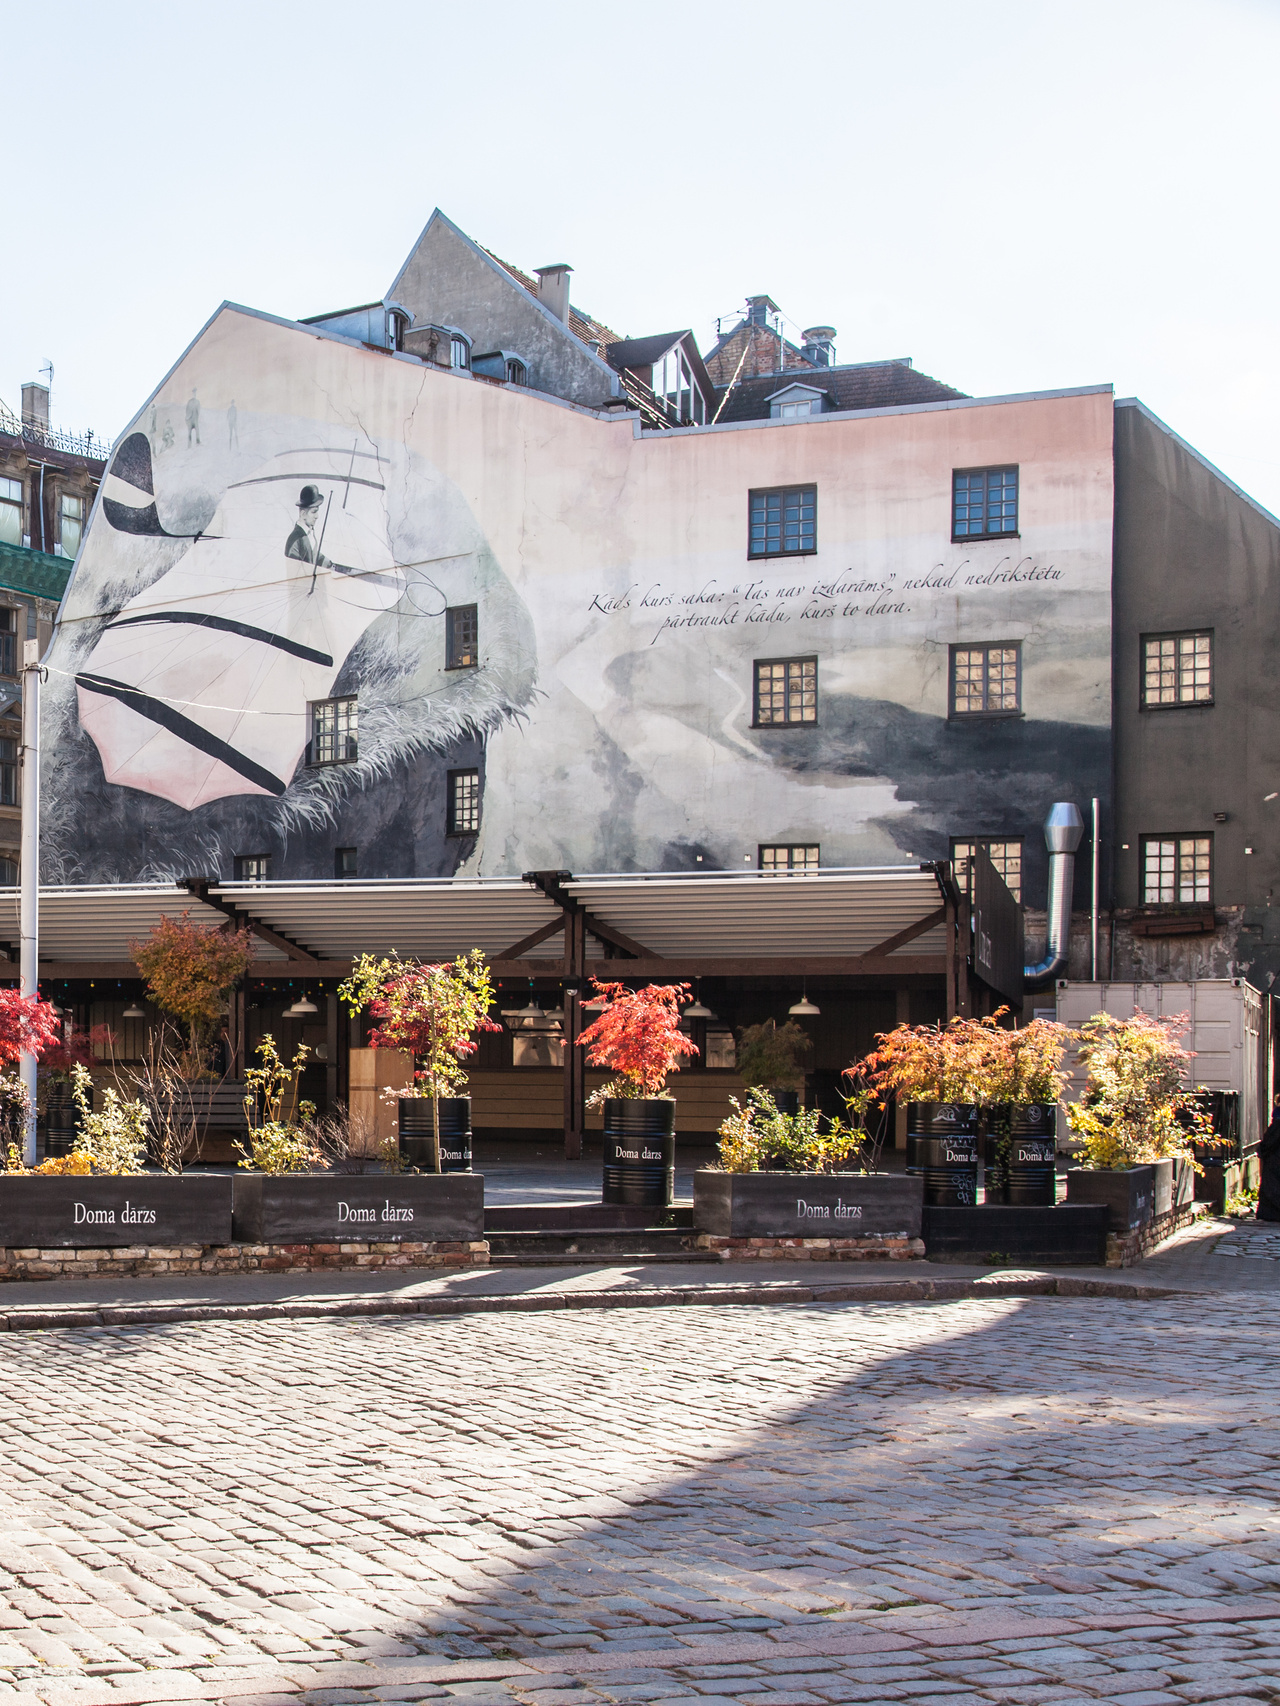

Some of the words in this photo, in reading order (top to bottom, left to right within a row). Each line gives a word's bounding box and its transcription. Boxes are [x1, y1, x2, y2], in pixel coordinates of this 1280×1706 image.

[588, 583, 639, 614] Kāds
[639, 583, 675, 608] kurš
[677, 579, 725, 605] saka:
[775, 585, 806, 599] nav
[902, 559, 970, 589] nekad
[964, 556, 1066, 587] nedrīkstētu
[649, 601, 740, 646] pārtraukt
[744, 601, 792, 624] kādu,
[799, 599, 838, 620] kurš
[842, 601, 862, 617] to
[865, 587, 912, 617] dara.
[439, 1147, 462, 1160] Doma
[615, 1145, 639, 1159] Doma
[641, 1145, 662, 1160] dārzs
[946, 1149, 969, 1162] Doma
[1018, 1149, 1042, 1162] Doma
[73, 1202, 116, 1224] Doma
[120, 1200, 157, 1224] dārzs
[337, 1200, 377, 1222] Doma
[381, 1199, 414, 1222] dārzs
[796, 1199, 830, 1219] Doma
[834, 1197, 862, 1219] dārzs
